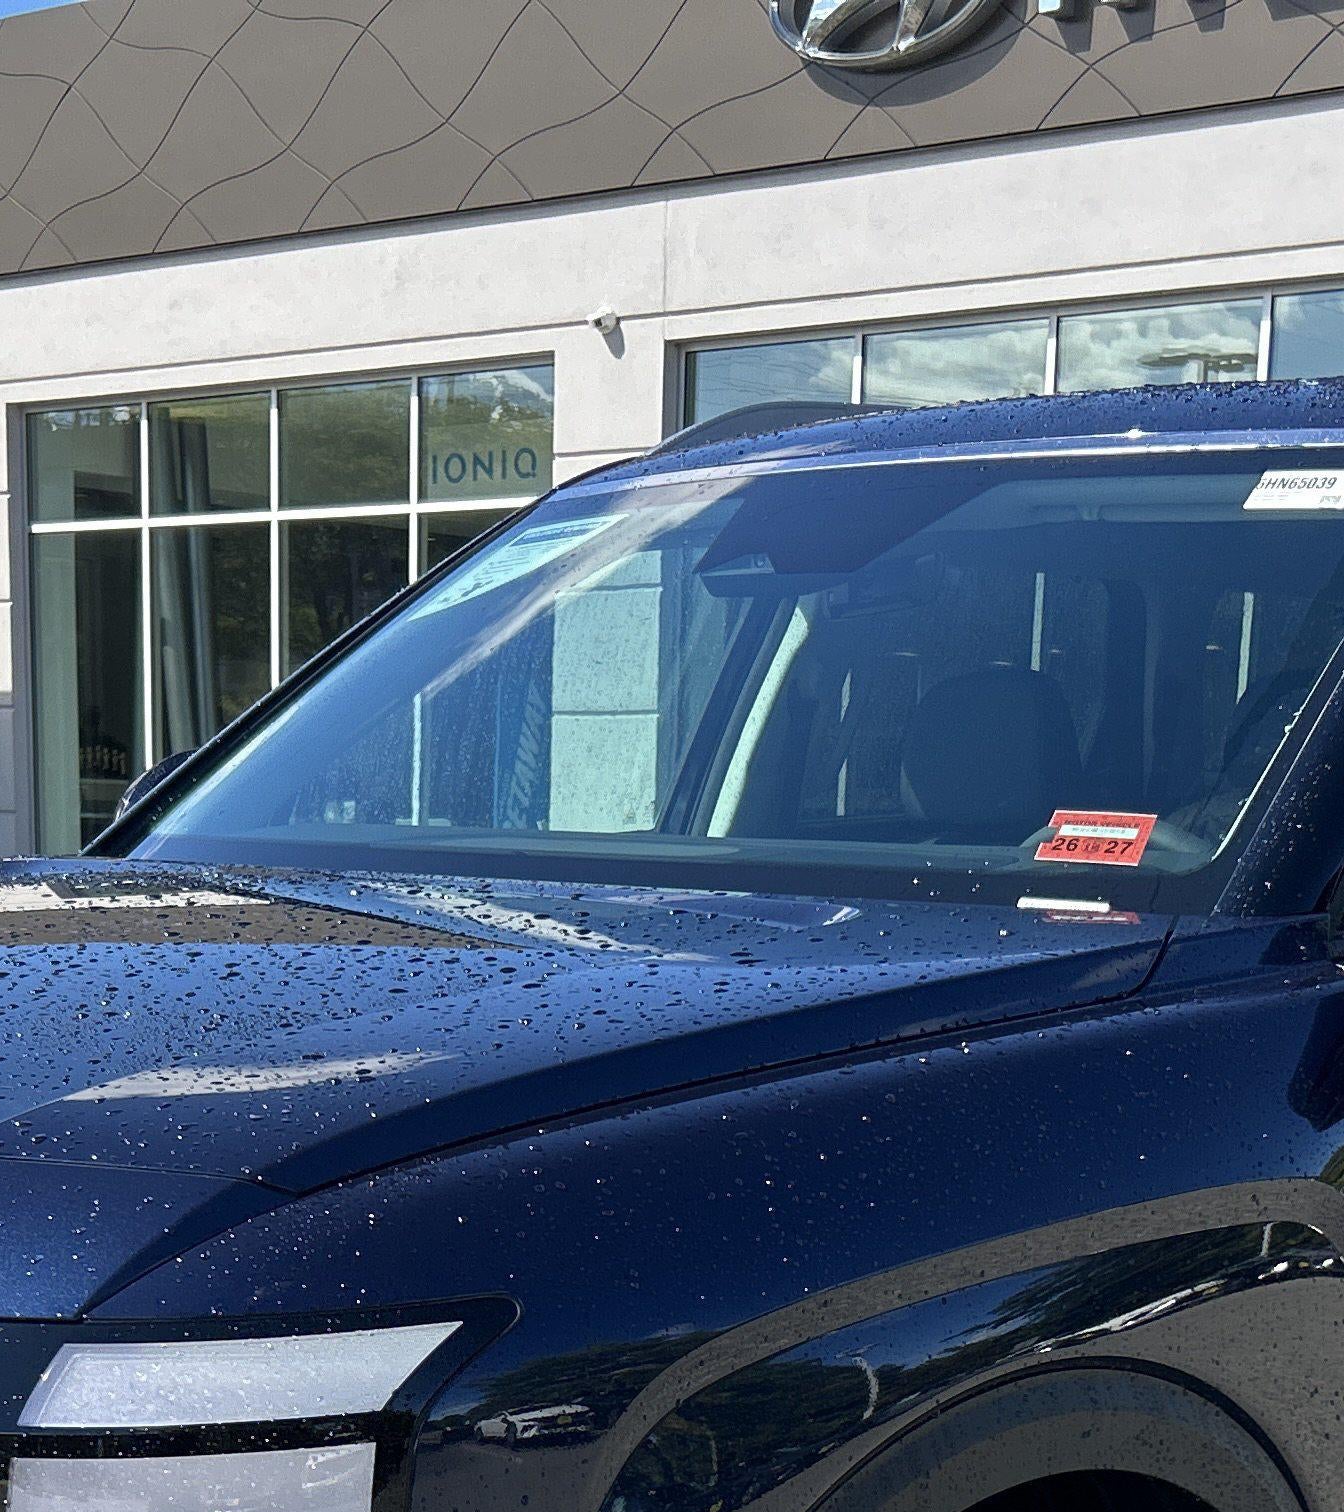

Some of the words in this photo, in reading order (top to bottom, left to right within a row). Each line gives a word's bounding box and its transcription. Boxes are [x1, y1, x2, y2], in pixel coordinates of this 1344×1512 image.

[432, 447, 537, 484] IONIQ
[1052, 838, 1079, 852] 26
[1104, 840, 1134, 855] 27
